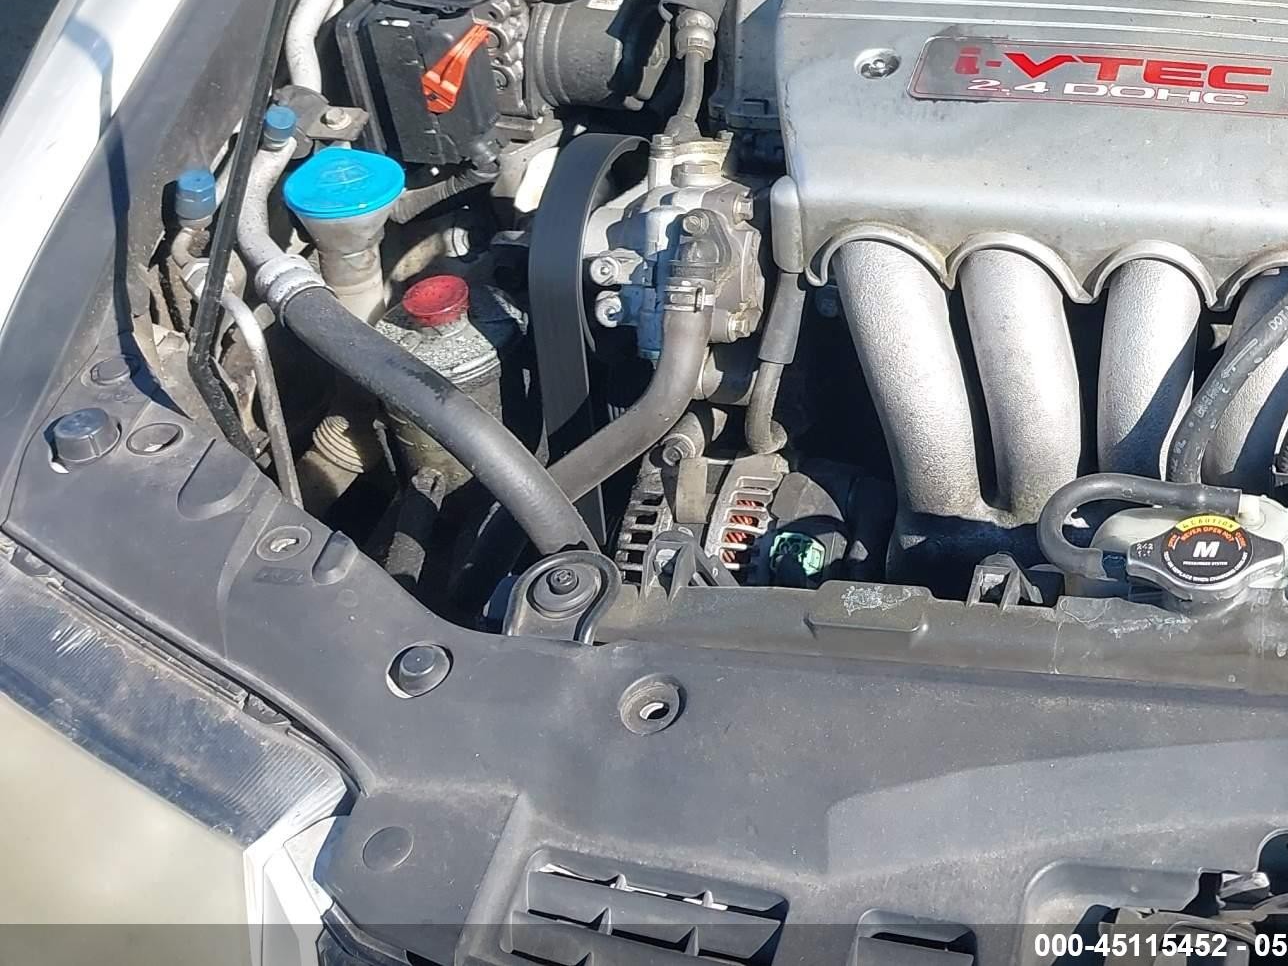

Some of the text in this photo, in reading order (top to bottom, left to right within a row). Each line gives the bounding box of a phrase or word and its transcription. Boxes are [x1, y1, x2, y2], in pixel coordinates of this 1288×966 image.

[954, 46, 1272, 92] i-VTEC
[966, 79, 1248, 106] 2.4 DOHC
[1203, 526, 1222, 535] OPEN
[1192, 541, 1220, 558] M
